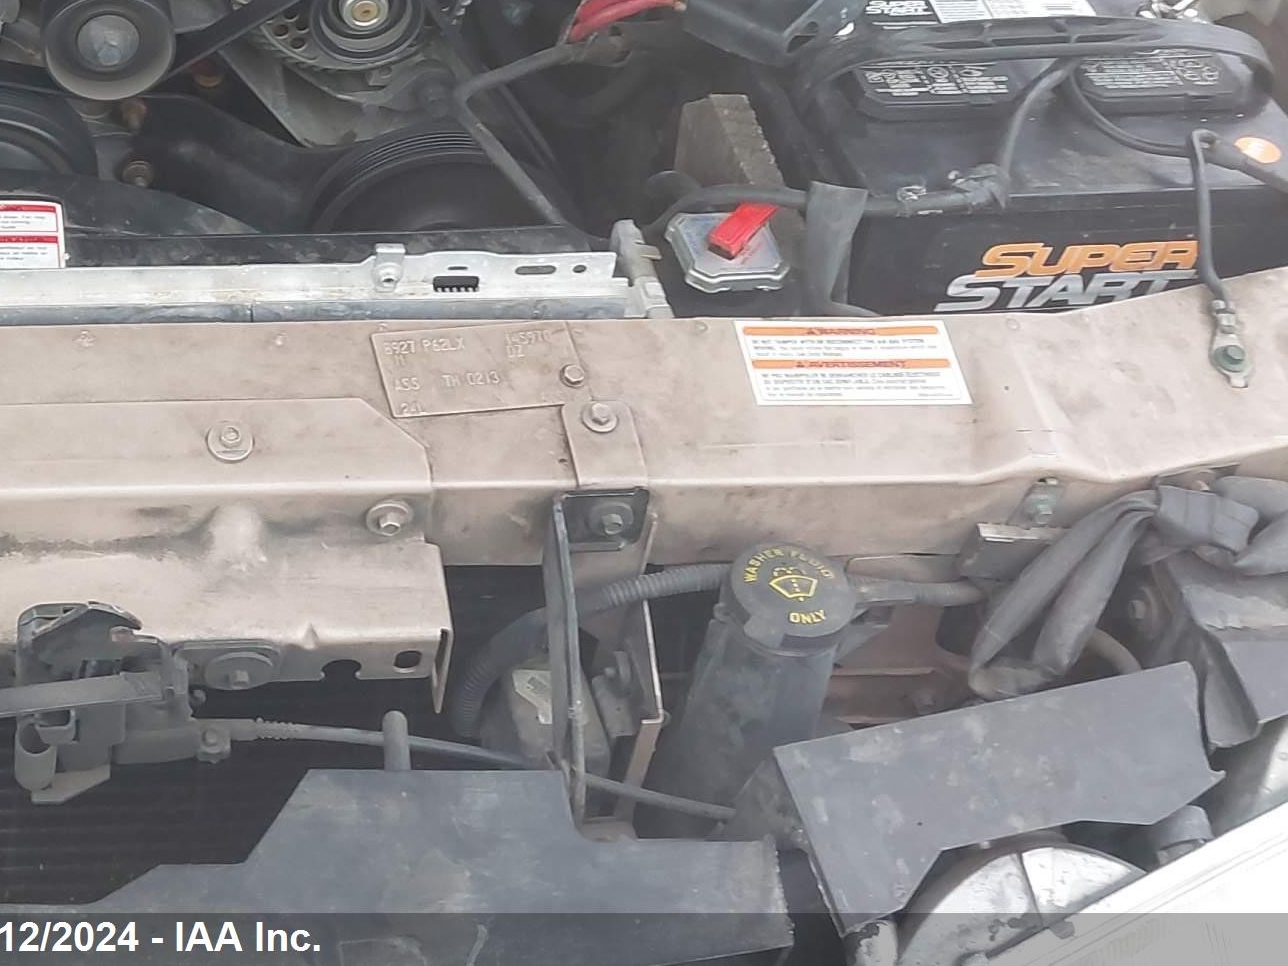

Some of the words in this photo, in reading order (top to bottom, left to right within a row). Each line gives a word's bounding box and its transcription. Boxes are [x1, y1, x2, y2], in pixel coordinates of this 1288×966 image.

[975, 240, 1199, 278] SUPER
[934, 270, 1199, 313] START
[743, 548, 785, 583] WASHER
[789, 549, 835, 580] FLUID
[789, 610, 827, 624] ONLY
